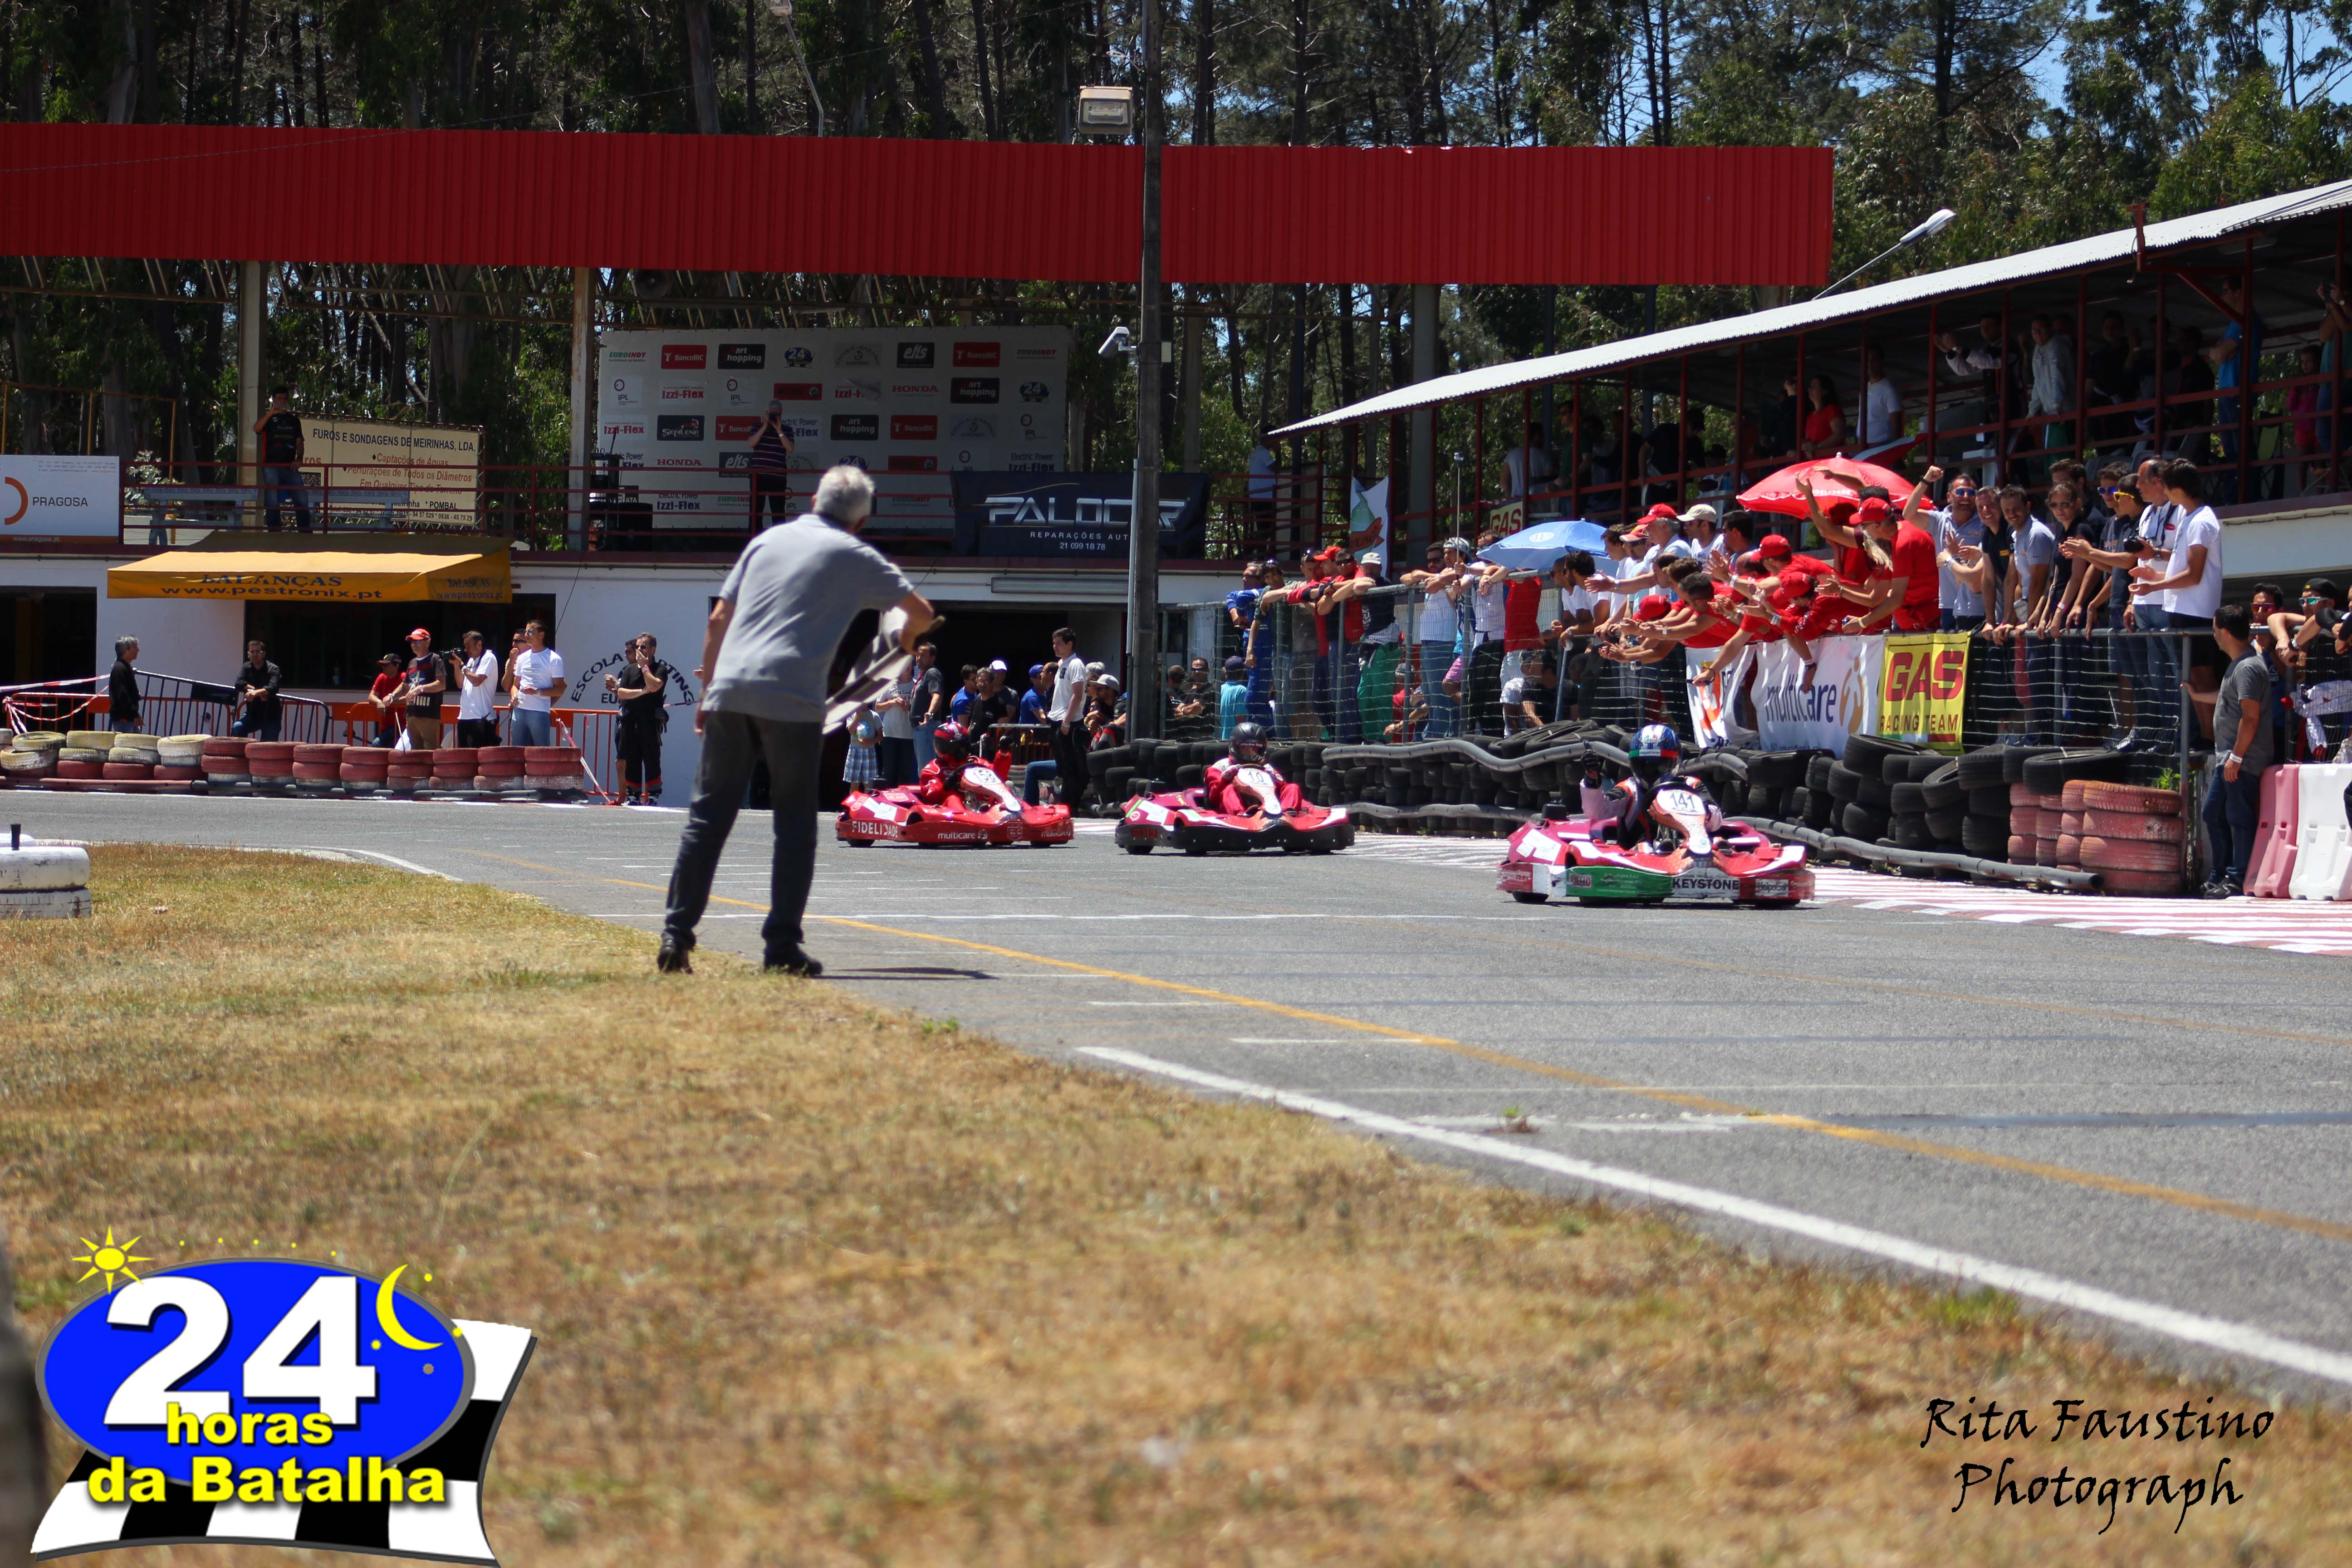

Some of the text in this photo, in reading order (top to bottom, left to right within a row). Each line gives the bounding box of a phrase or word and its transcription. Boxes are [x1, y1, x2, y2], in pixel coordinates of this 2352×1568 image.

[789, 348, 806, 359] 24
[1024, 383, 1041, 393] 24
[662, 390, 704, 399] Izzi-Flex
[604, 426, 644, 434] Izzi-Flex
[313, 428, 340, 441] FUROS
[342, 432, 347, 442] E
[349, 433, 398, 446] SONDAGENS
[401, 437, 412, 447] DE
[459, 441, 476, 452] LDA.
[377, 452, 414, 465] Captações
[416, 456, 425, 465] de
[1011, 452, 1054, 461] Electric Power
[1009, 463, 1055, 472] Izzi-Flex
[392, 468, 402, 477] de
[404, 470, 424, 479] Todos
[436, 470, 472, 482] Diâmetros
[360, 479, 372, 487] Em
[33, 496, 88, 507] PRAGOSA
[429, 501, 459, 510] POMBAL
[657, 501, 701, 510] Izzi-Flex
[984, 496, 1187, 531] PALOCR
[1490, 508, 1522, 536] GAS
[1030, 531, 1102, 541] REPARAÇÕES
[1096, 543, 1106, 551] 78
[447, 578, 491, 588] BALANÇAS
[161, 587, 382, 599] www.pestronix.pt
[570, 652, 695, 706] ESCOLA RTING
[1885, 651, 1965, 701] GAS
[1766, 673, 1837, 723] multicare
[1880, 714, 1959, 731] RACING TEAM
[973, 769, 996, 782] 158
[1248, 771, 1264, 782] 10
[1669, 792, 1695, 809] 141
[852, 820, 898, 838] FIDELIDADE
[937, 831, 976, 840] multicare
[1672, 879, 1740, 890] KEYSTONE
